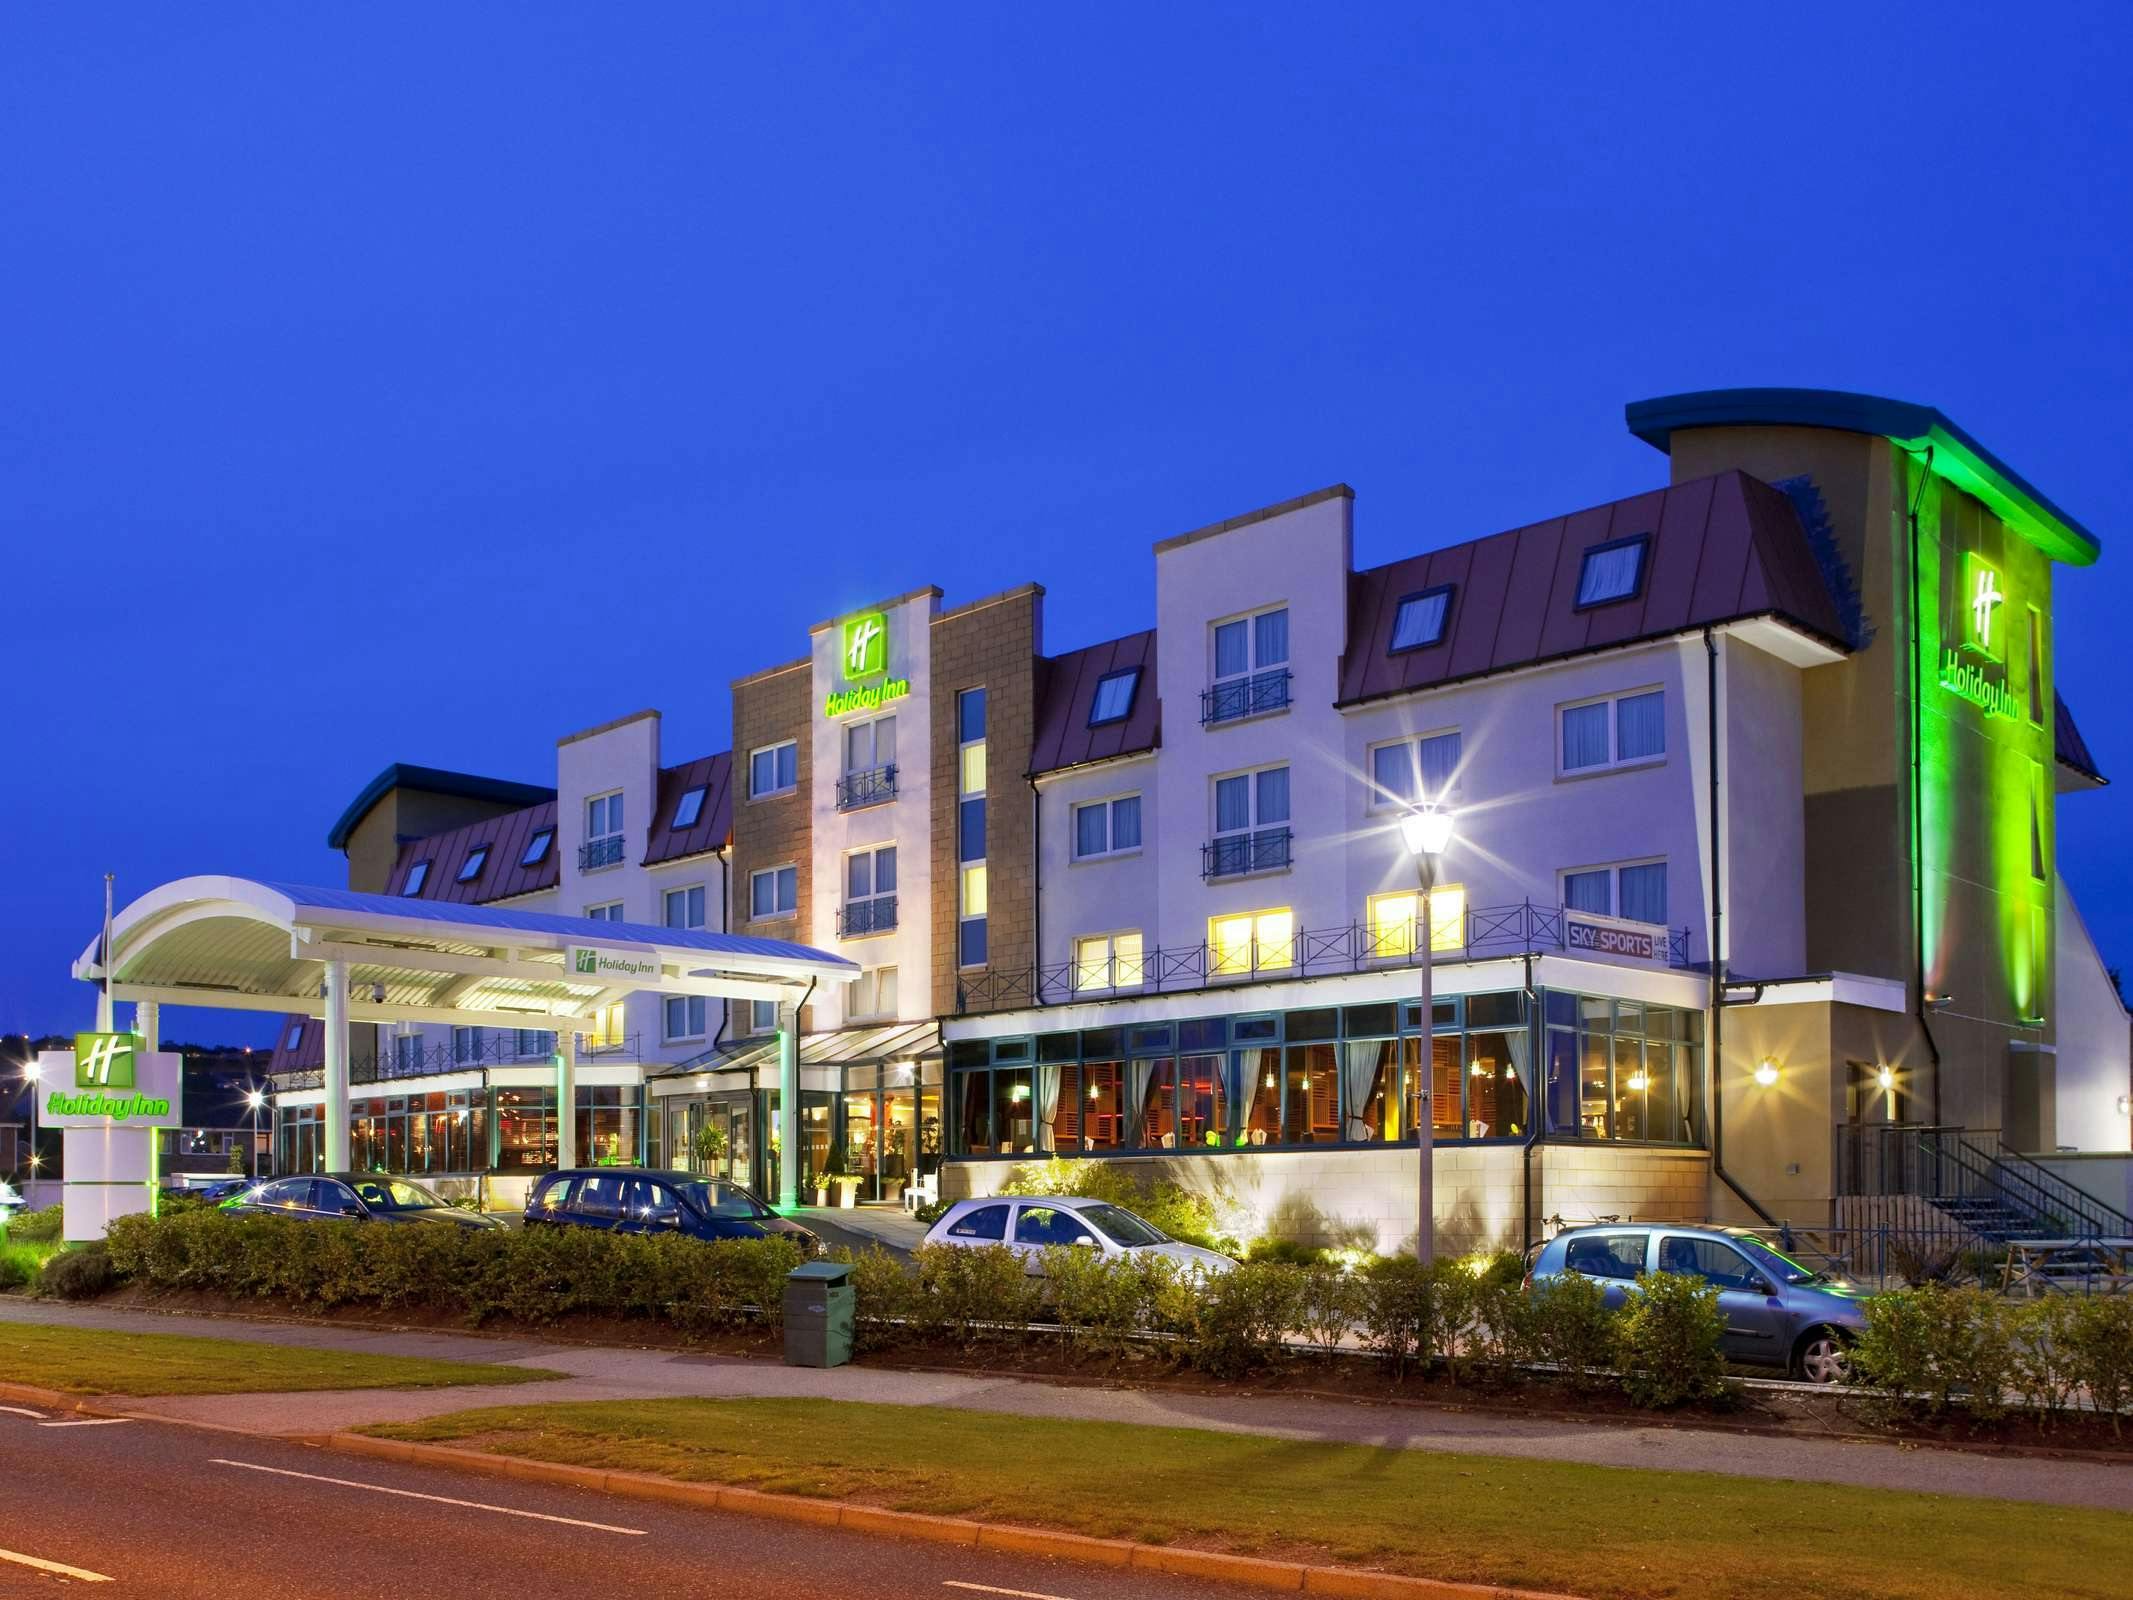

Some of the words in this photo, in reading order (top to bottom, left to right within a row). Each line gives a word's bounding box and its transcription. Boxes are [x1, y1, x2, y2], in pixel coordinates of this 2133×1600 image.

[825, 685, 881, 718] Holiday
[881, 677, 910, 701] Inn
[1944, 648, 1999, 719] Holiday
[2000, 678, 2019, 721] Inn
[1570, 926, 1597, 946] SKY
[1600, 931, 1651, 956] SPORTS
[598, 956, 638, 974] Holiday
[638, 960, 655, 974] Inn
[47, 1092, 130, 1121] Holiday
[130, 1091, 170, 1117] Inn
